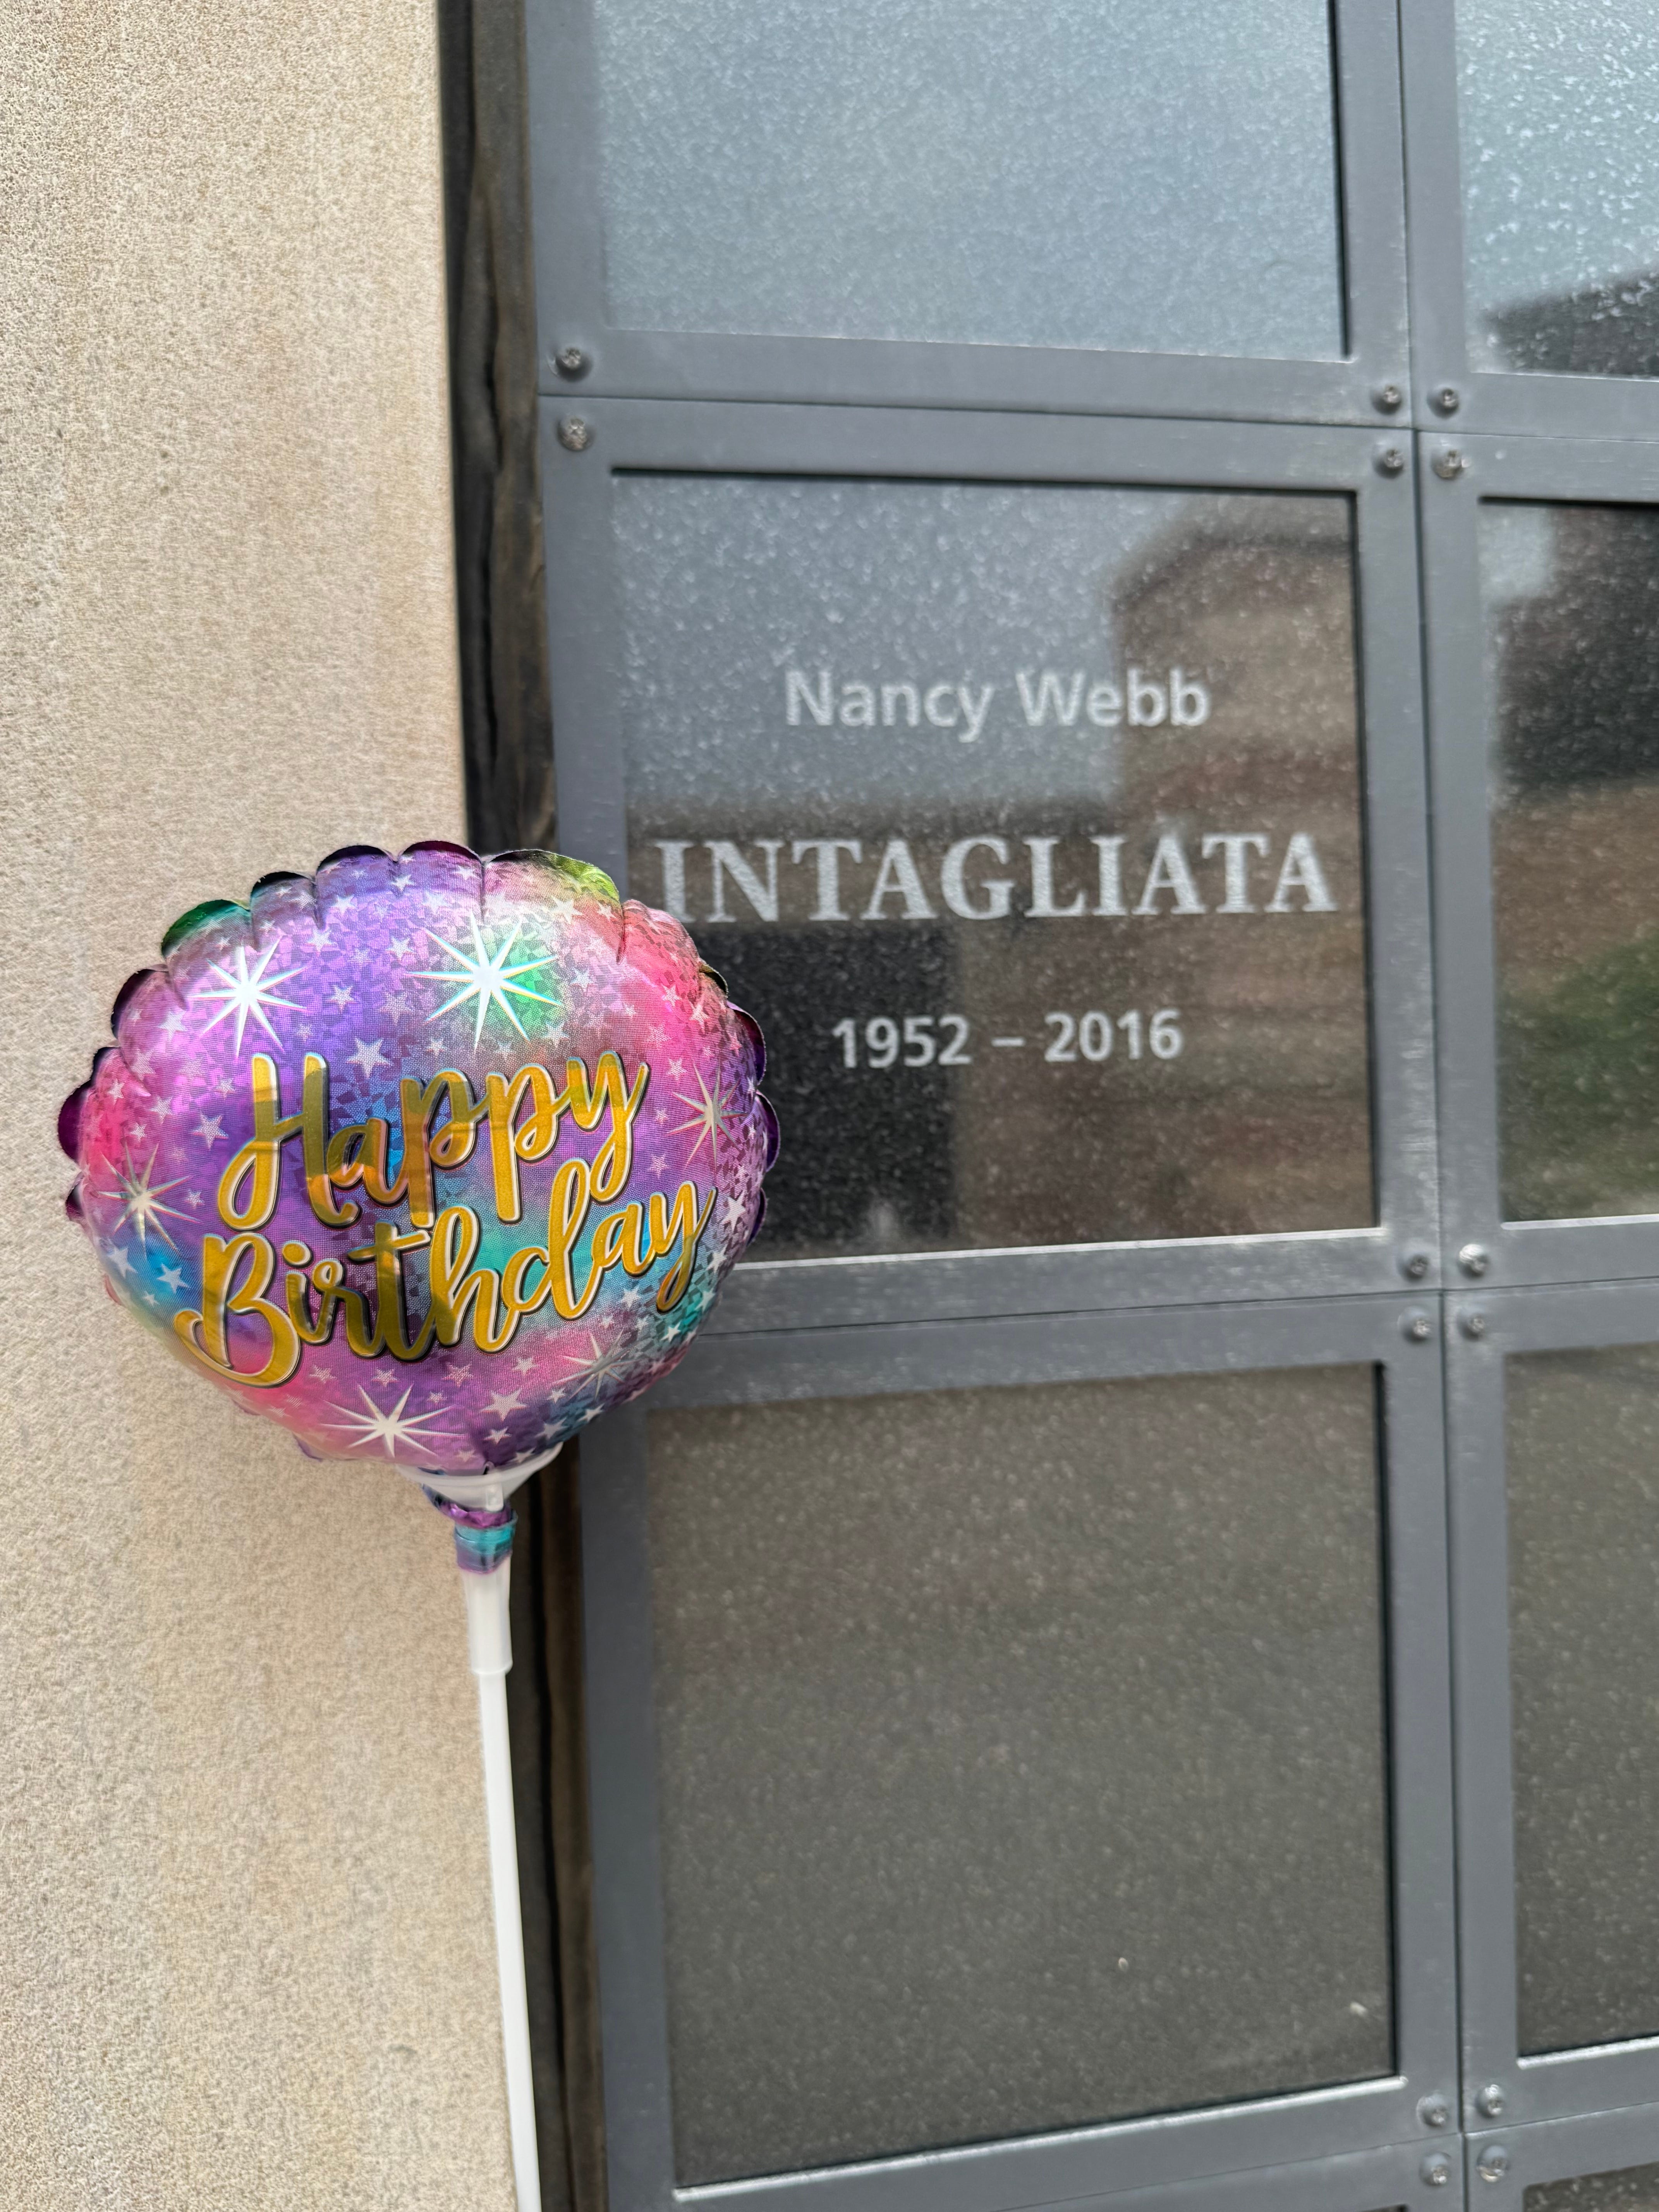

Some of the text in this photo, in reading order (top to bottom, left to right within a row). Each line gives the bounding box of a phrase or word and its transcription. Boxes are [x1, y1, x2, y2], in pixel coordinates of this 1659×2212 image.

[785, 666, 1211, 742] Nancy Webb
[654, 833, 1339, 924] INTAGLIATA
[833, 1016, 971, 1069] 1952
[1044, 1009, 1183, 1062] 2016
[219, 1050, 648, 1231] Happy
[173, 1158, 716, 1387] Birthday
